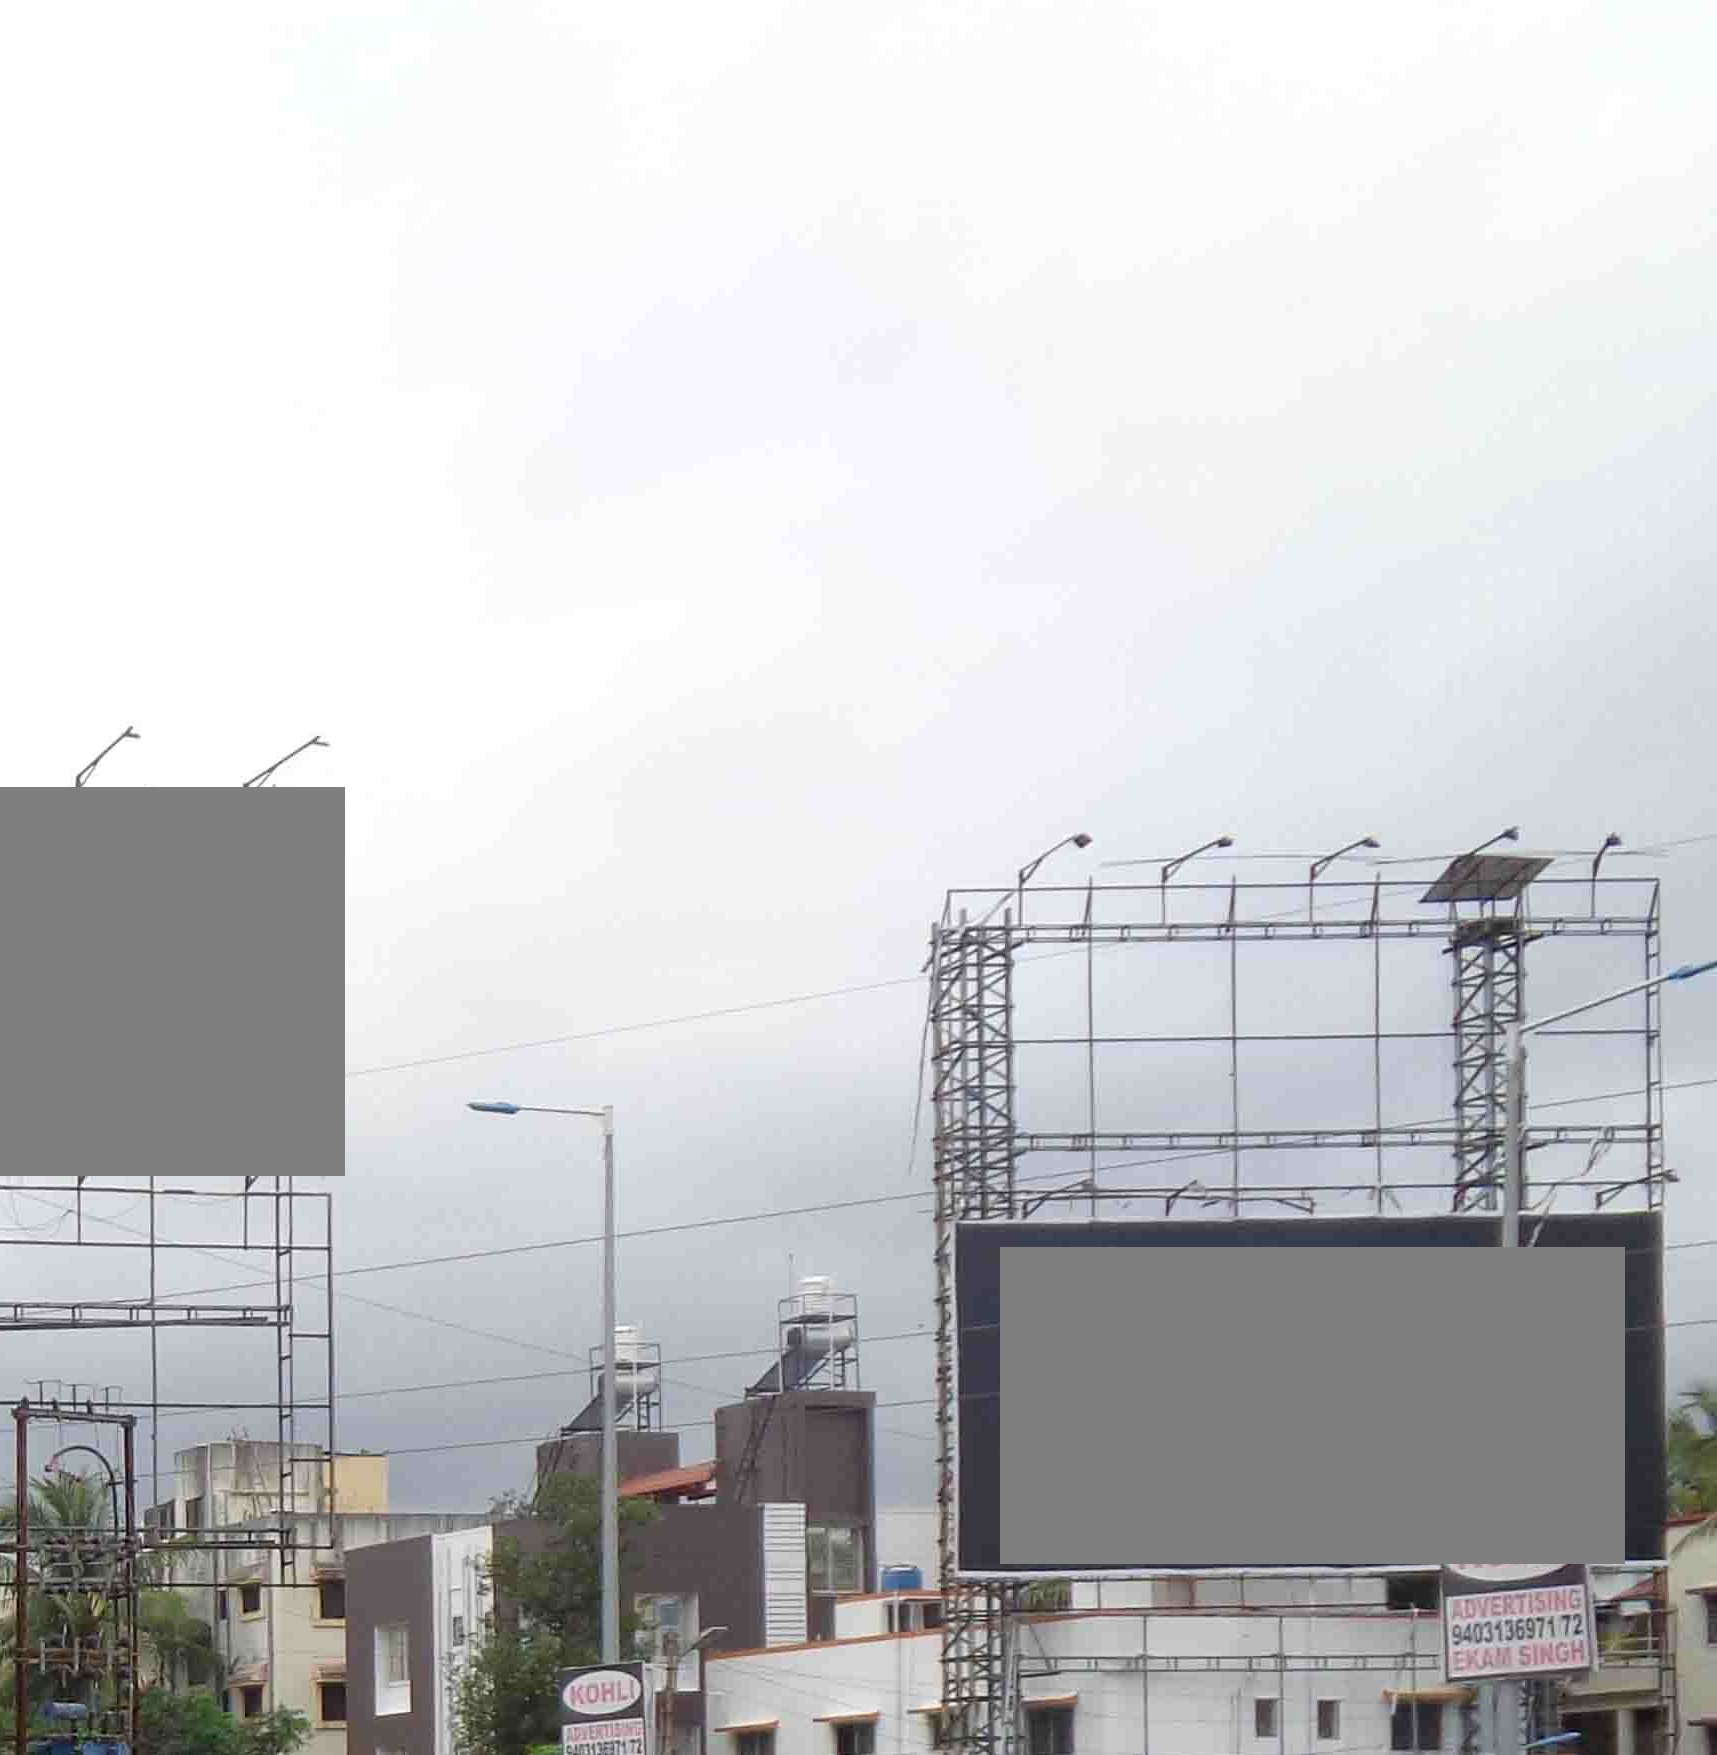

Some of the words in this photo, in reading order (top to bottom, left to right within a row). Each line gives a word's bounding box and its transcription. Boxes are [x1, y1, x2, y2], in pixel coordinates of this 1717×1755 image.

[1452, 1588, 1583, 1618] ADVERTISING
[1452, 1616, 1556, 1646] 9403136971
[1560, 1613, 1584, 1636] 72
[1452, 1647, 1511, 1672] EKAM
[1518, 1640, 1584, 1667] SINGH
[571, 1680, 634, 1704] KOHLI
